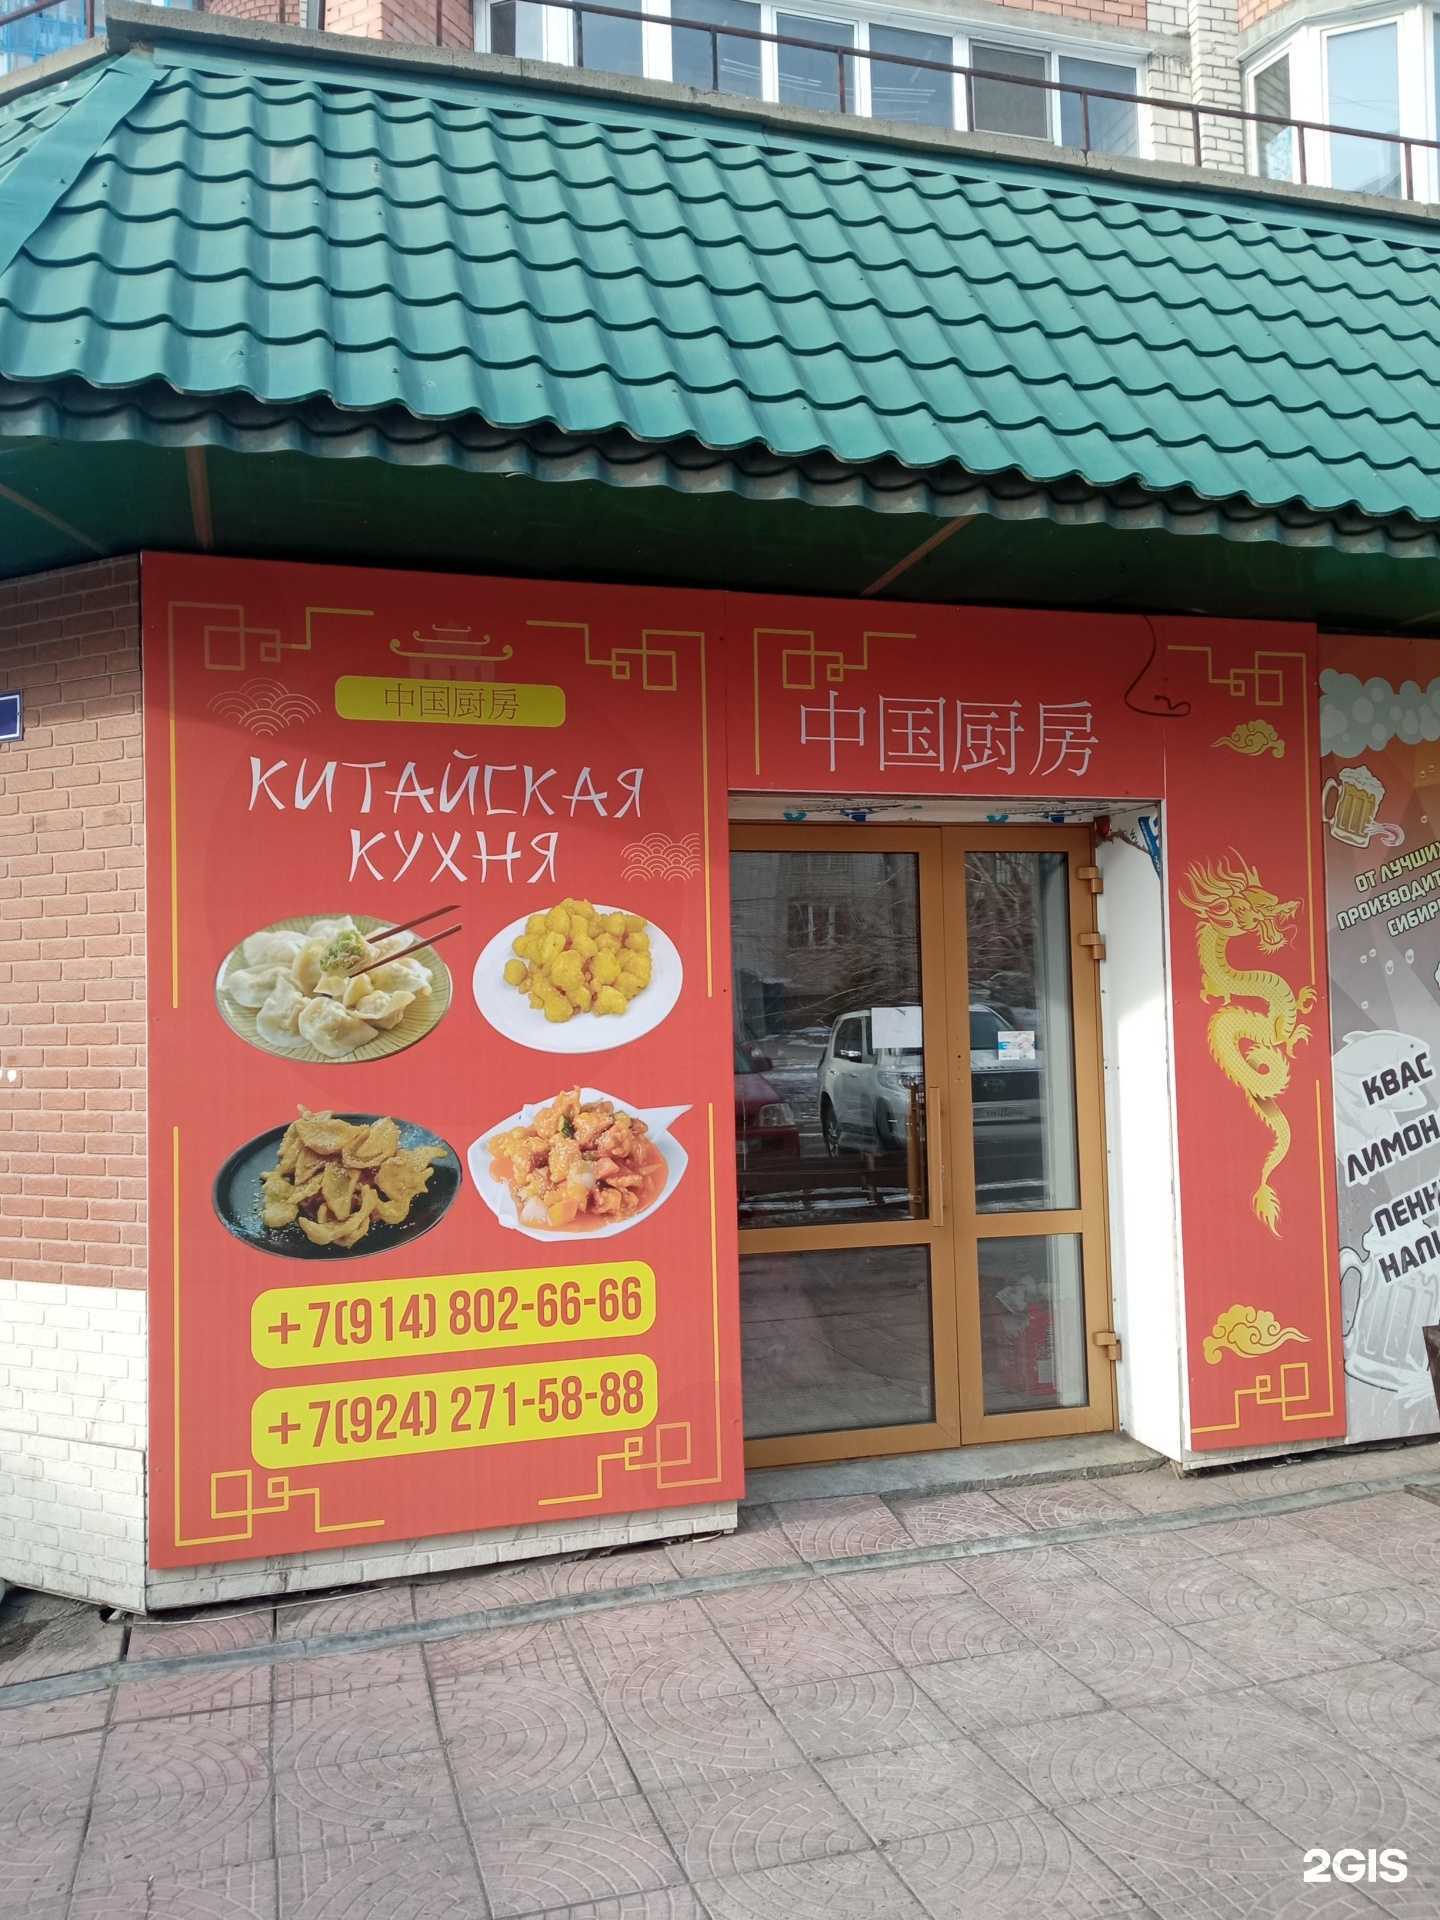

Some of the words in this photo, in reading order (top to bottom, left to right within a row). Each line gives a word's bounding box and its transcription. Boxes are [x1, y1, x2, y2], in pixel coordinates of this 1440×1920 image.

[383, 683, 519, 720] 中国厨房
[801, 690, 1099, 776] 中国厨房
[249, 751, 643, 817] КИТАЙСКАЯ
[349, 829, 558, 884] КУХНЯ
[1355, 870, 1376, 892] ОТ
[1362, 1052, 1433, 1105] КВАС
[1346, 1114, 1440, 1182] ЛИМОН
[1374, 1179, 1440, 1237] ПЕНН
[449, 1276, 642, 1336] 802-66-66
[449, 1370, 644, 1433] 271-58-88
